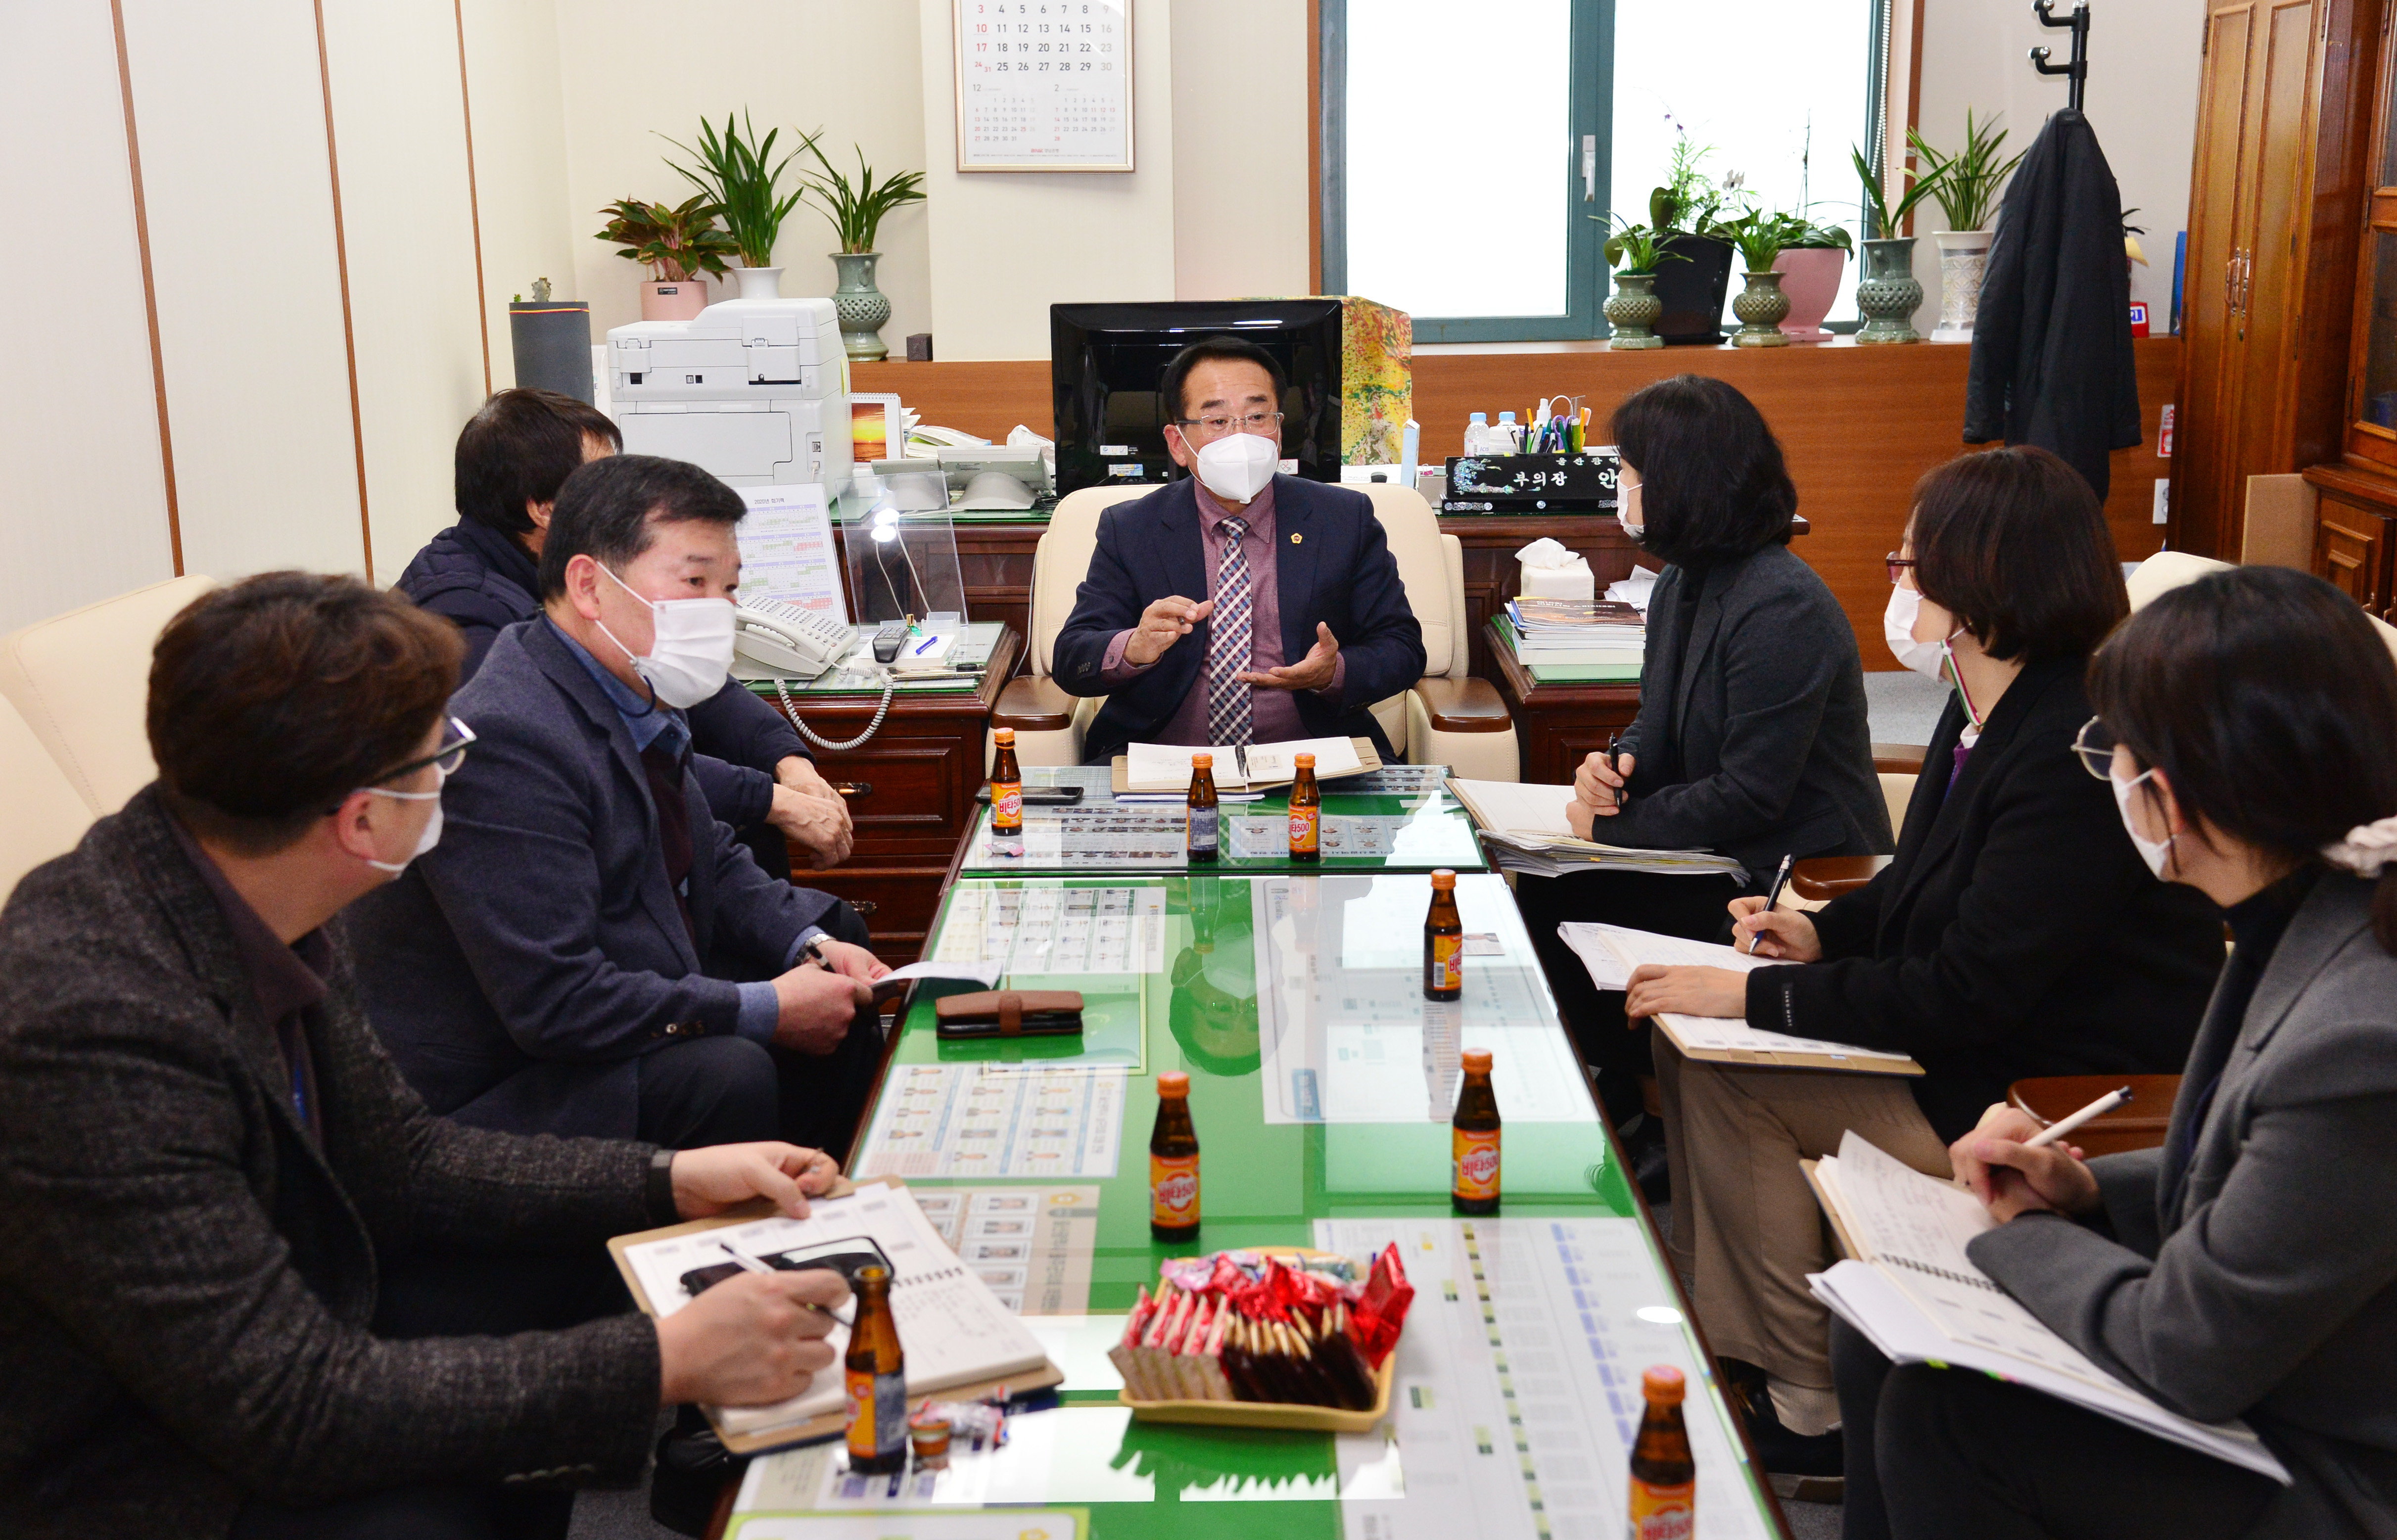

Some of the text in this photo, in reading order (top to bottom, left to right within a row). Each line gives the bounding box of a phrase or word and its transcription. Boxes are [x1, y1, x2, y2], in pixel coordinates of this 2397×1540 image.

[979, 5, 984, 13] 3
[1020, 5, 1025, 13] 5
[1041, 5, 1046, 13] 6
[1062, 5, 1067, 13] 7
[1082, 5, 1088, 13] 8
[1103, 5, 1109, 13] 9
[977, 24, 987, 32] 10
[1019, 24, 1028, 33] 12
[1039, 24, 1049, 33] 13
[1081, 24, 1090, 33] 15
[1102, 24, 1112, 33] 16
[1101, 44, 1112, 52] 23
[997, 62, 1008, 71] 25
[1101, 62, 1112, 71] 30
[1513, 468, 1618, 489] 부의장 안
